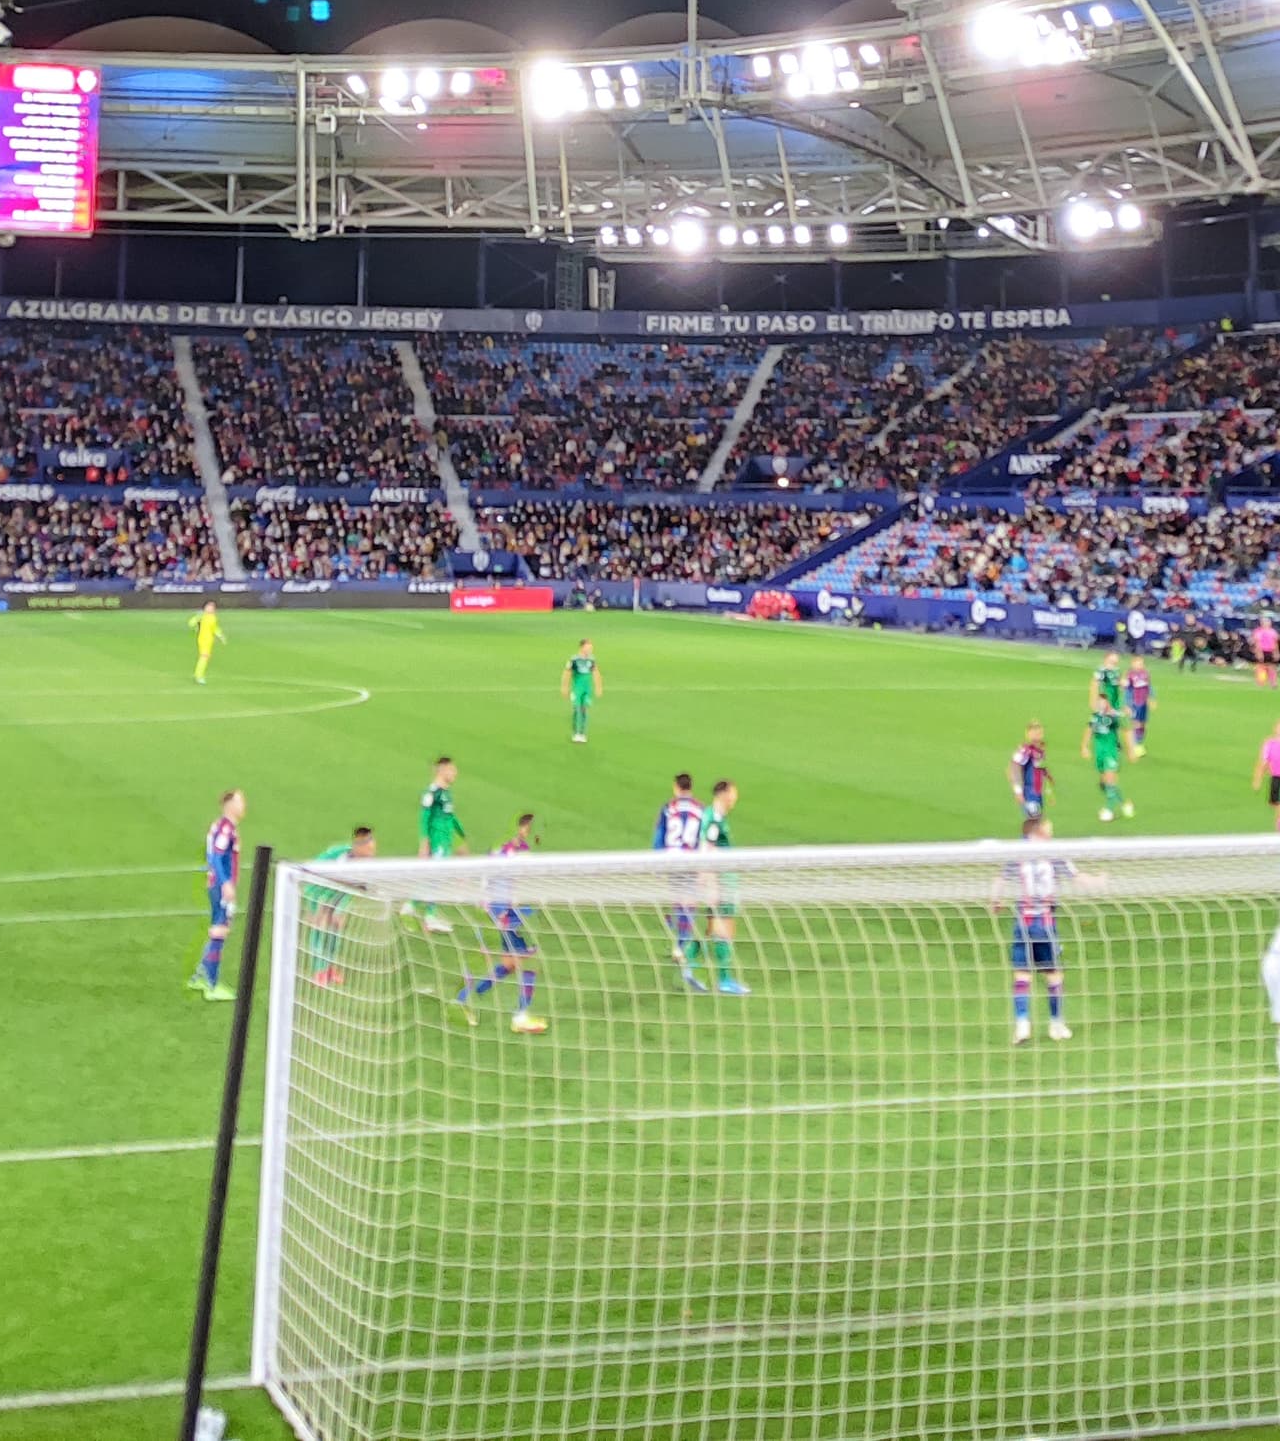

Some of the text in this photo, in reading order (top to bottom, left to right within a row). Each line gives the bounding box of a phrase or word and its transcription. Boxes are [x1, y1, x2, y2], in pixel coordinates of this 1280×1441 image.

[6, 300, 169, 322] AZULGRANAS
[177, 305, 209, 324] DE
[218, 306, 246, 325] TU
[359, 310, 443, 330] JERSEY
[646, 308, 1071, 333] FIRME TU PASO EL TRIUNFO TE ESPERA
